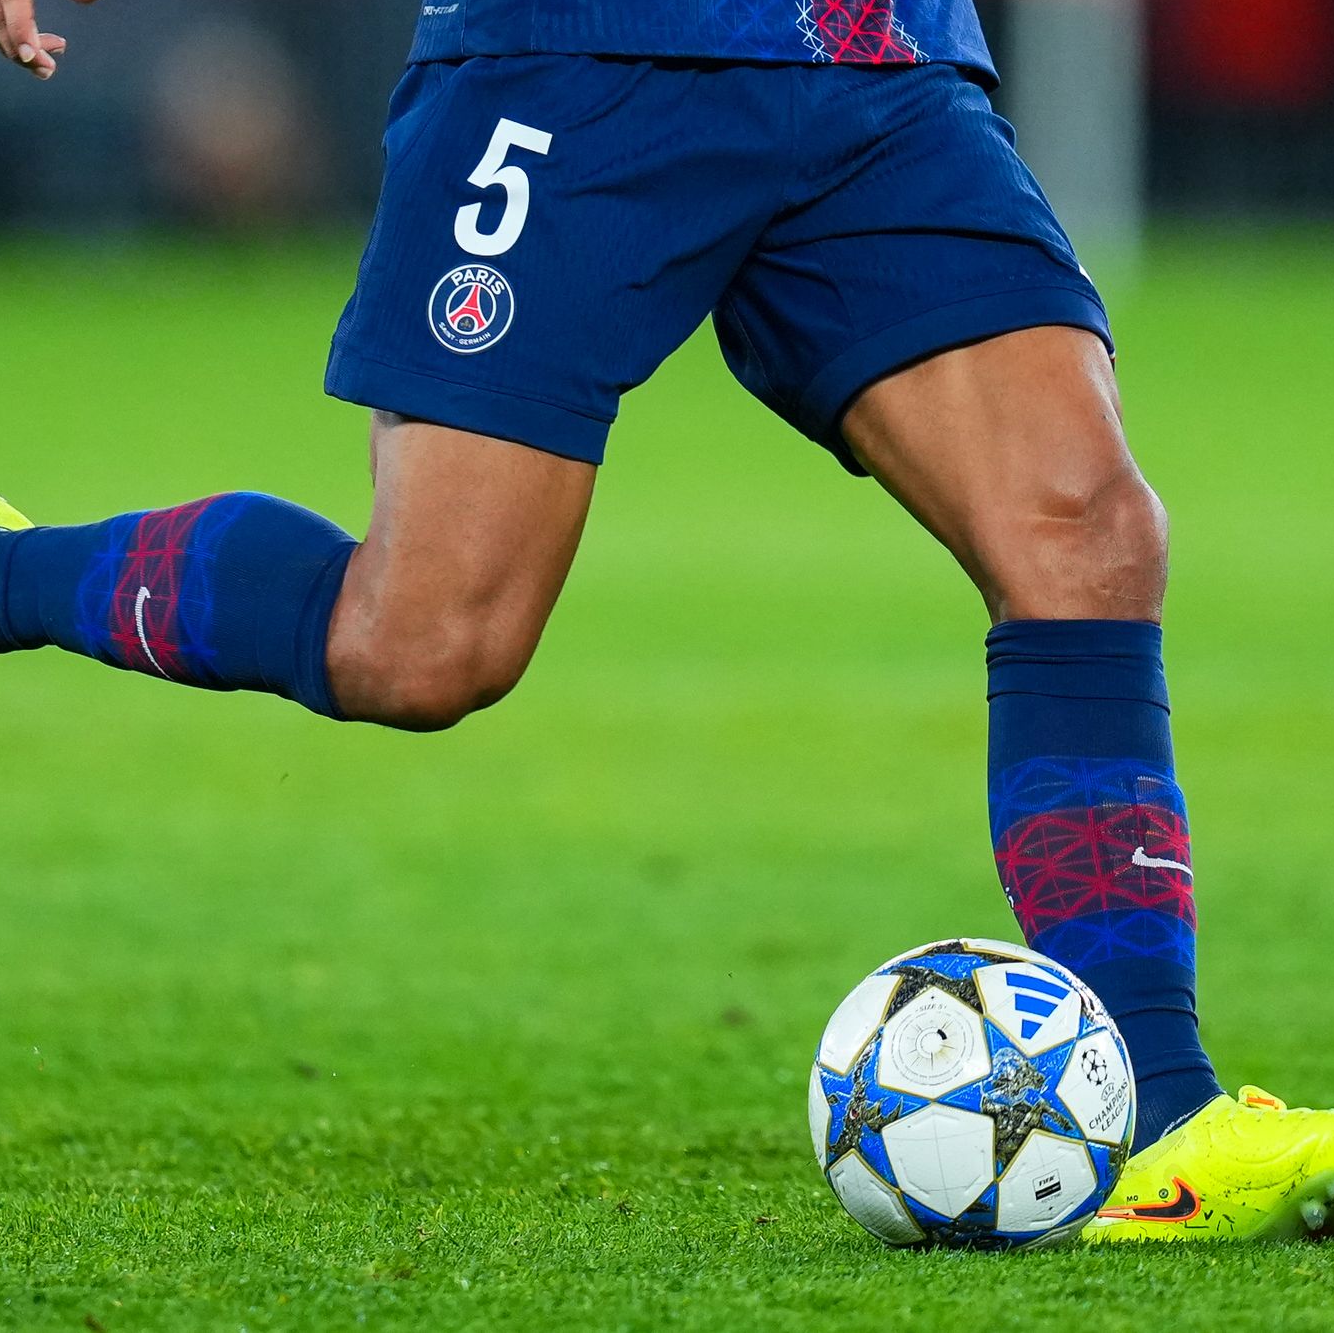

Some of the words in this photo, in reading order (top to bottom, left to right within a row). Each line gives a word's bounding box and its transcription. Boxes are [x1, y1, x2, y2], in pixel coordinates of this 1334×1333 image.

[454, 117, 553, 256] 5
[451, 269, 505, 295] PARIS
[1088, 1077, 1128, 1130] CHAMPIONS
